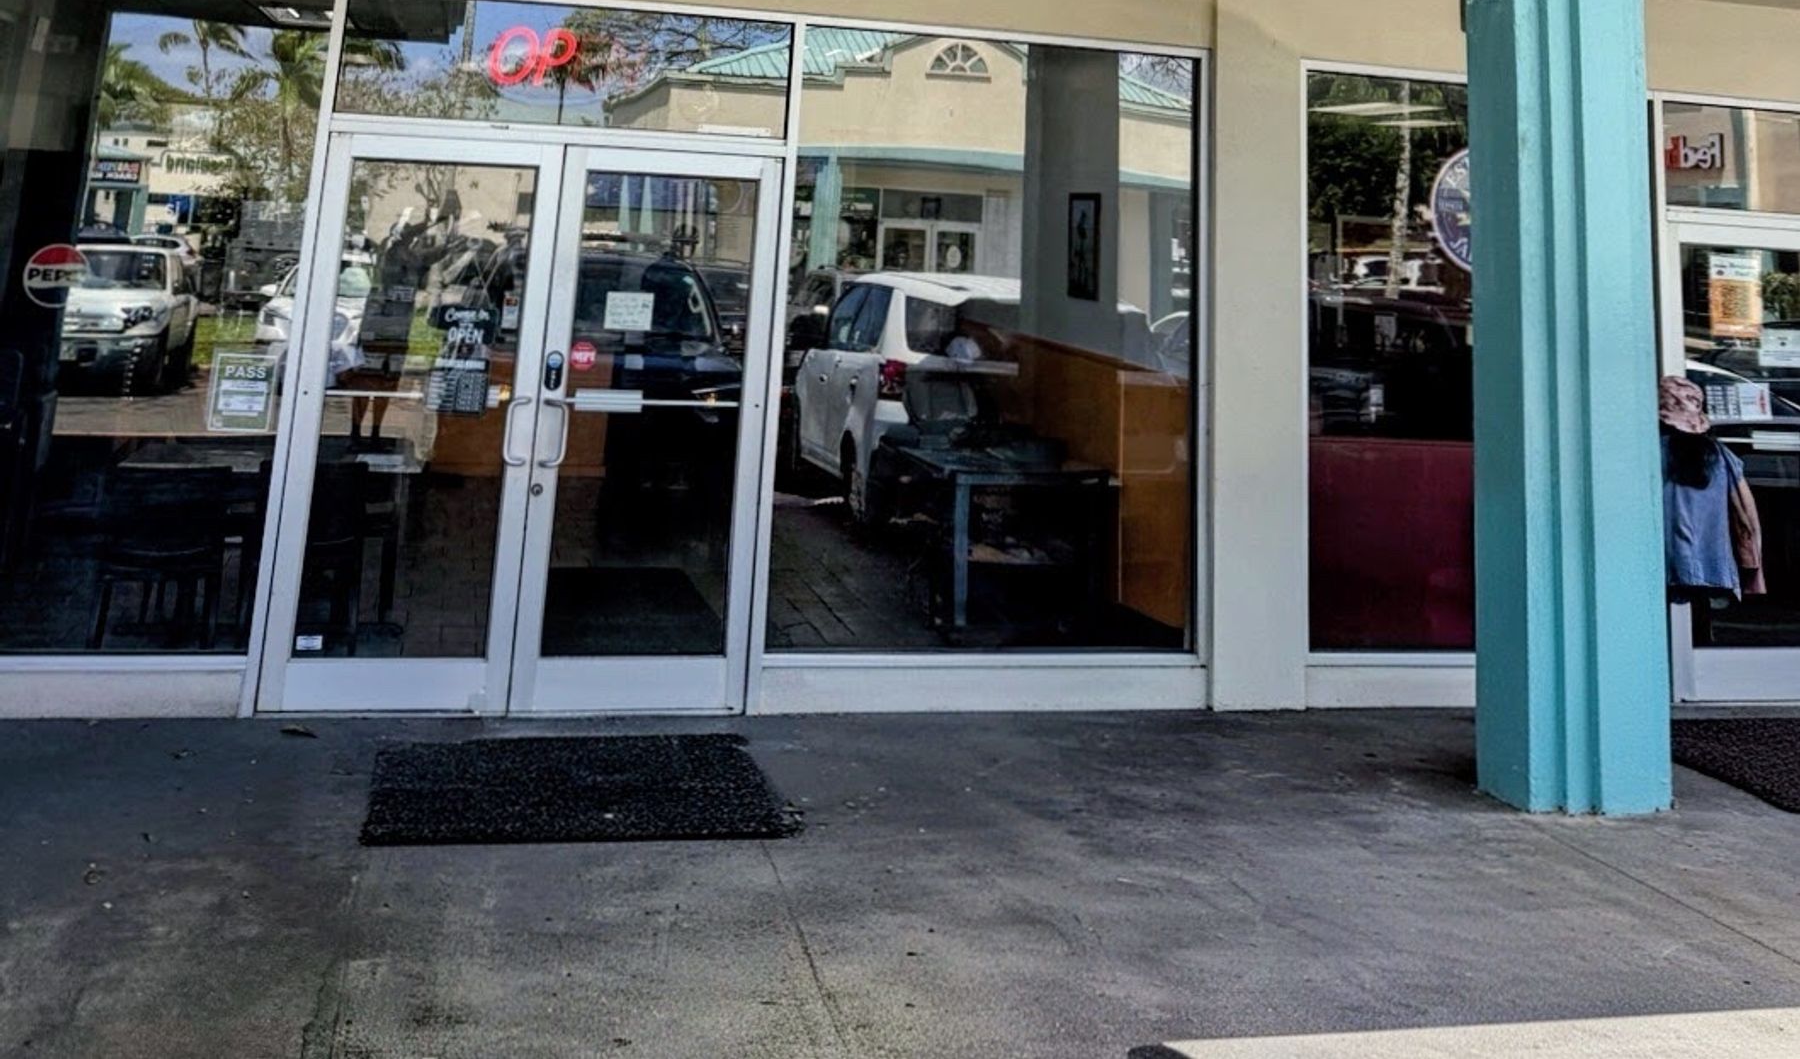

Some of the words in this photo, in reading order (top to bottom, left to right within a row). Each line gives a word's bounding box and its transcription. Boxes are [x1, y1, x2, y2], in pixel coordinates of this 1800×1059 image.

[27, 268, 79, 282] PEP
[448, 326, 485, 345] OPEN
[225, 365, 267, 379] PASS
